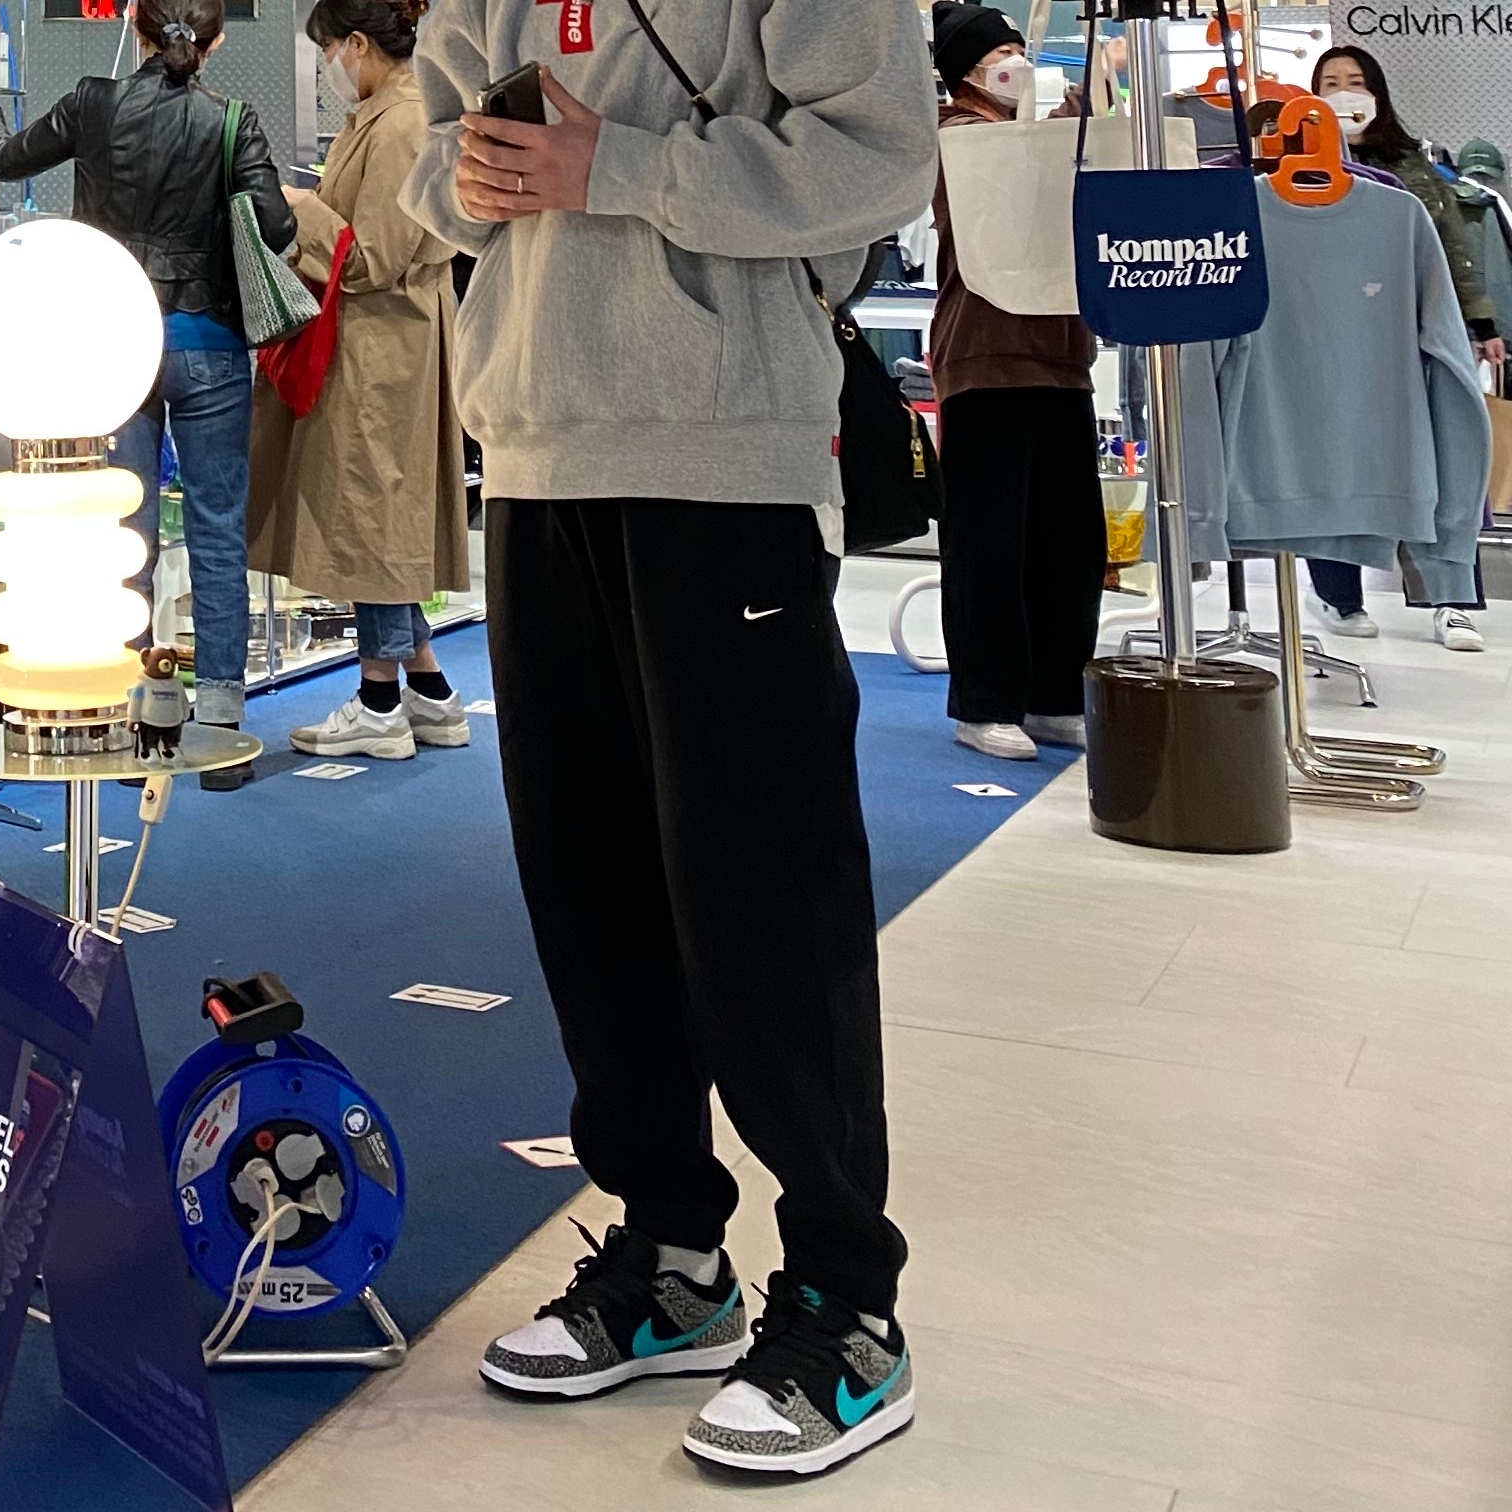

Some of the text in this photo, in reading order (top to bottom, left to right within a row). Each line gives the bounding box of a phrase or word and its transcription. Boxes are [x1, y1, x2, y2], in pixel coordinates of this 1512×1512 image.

[1346, 4, 1464, 36] Calvin
[1097, 231, 1250, 269] kompakt
[1107, 261, 1243, 289] Record Bar
[279, 1282, 305, 1304] 25
